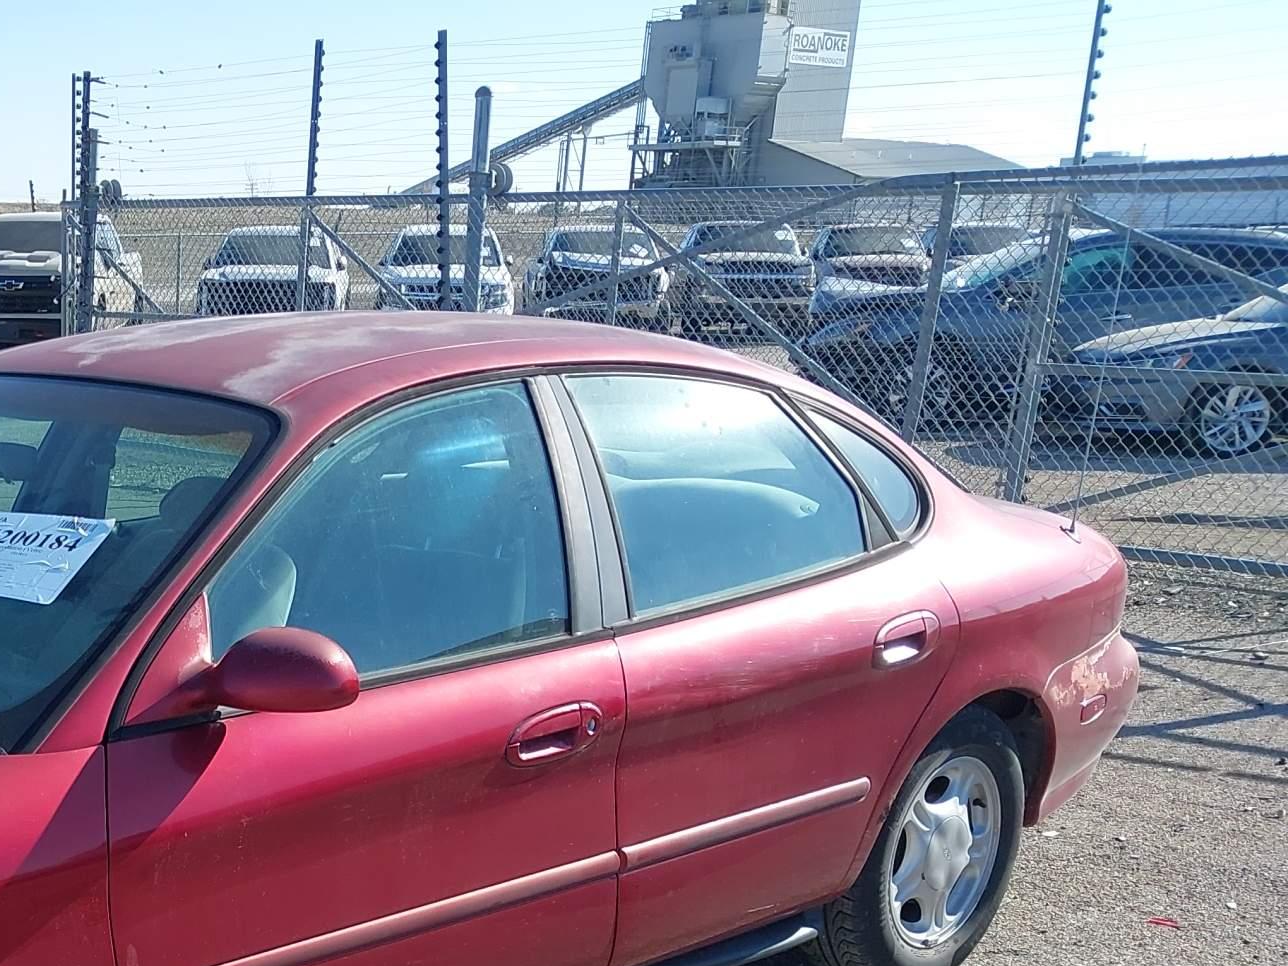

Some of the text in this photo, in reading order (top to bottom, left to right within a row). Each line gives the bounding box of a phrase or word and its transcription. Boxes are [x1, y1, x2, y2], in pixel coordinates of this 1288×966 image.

[793, 33, 848, 52] ROANOKE
[791, 54, 845, 66] CONCRETE PRODUCTS
